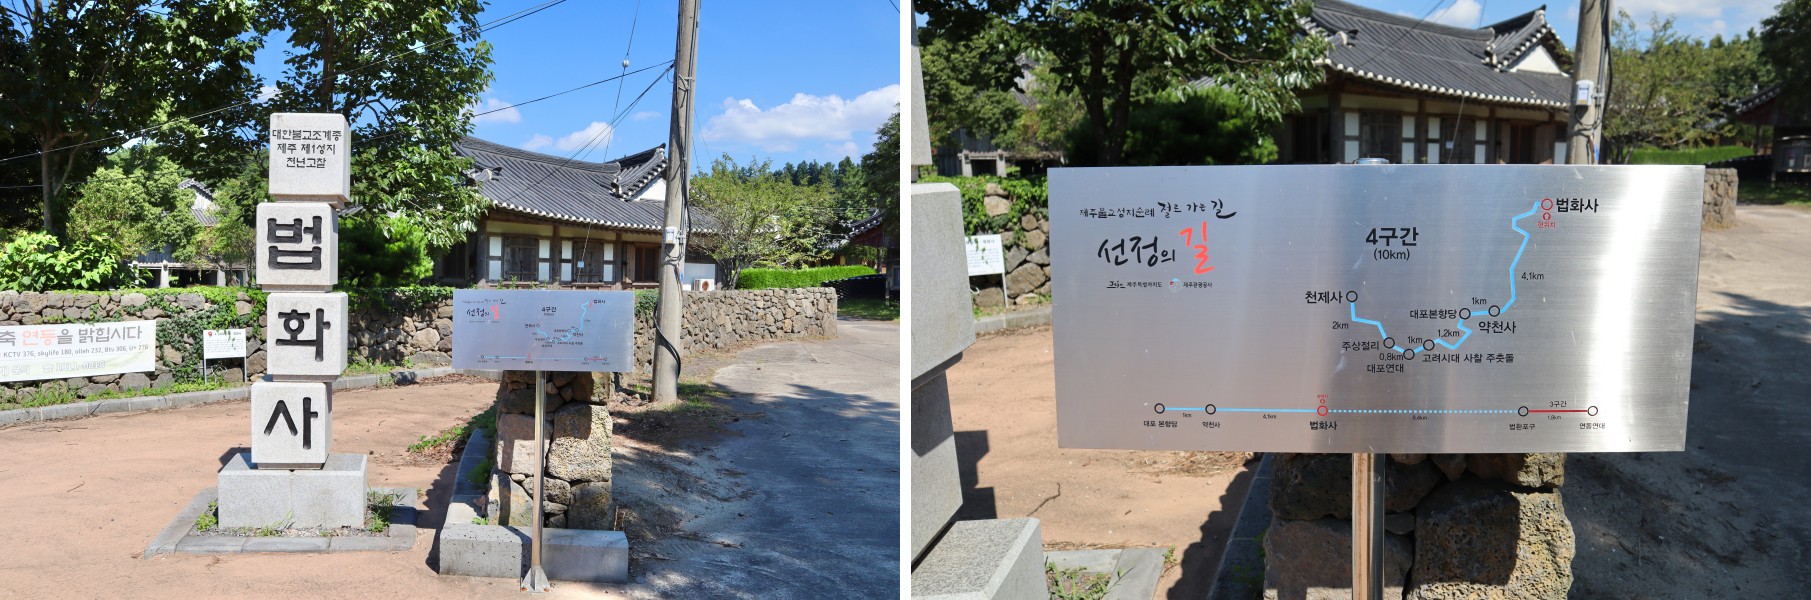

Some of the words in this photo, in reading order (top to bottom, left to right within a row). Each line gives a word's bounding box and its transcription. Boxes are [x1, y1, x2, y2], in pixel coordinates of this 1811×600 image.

[272, 128, 342, 142] 대한불교조계종
[277, 143, 297, 154] 제주
[301, 143, 336, 154] 제1성지
[286, 157, 326, 168] 천년고찰
[1079, 206, 1154, 218] 제주불교성지순례
[1186, 202, 1206, 212] 가는
[1210, 198, 1237, 219] 길
[1556, 198, 1598, 213] 법화사
[1365, 227, 1419, 246] 4구간
[1098, 236, 1176, 267] 선정의
[1179, 221, 1215, 274] 길
[1374, 249, 1410, 261] (10km)
[1305, 291, 1343, 304] 천제사
[1410, 309, 1457, 319] 대포본향당
[1332, 321, 1348, 329] 2km
[1479, 321, 1516, 334] 약천사
[22, 328, 73, 346] 연등을
[78, 325, 142, 343] 밝힙시다
[264, 216, 331, 450] 법화사
[1438, 329, 1460, 338] 1.2km
[1342, 341, 1379, 351] 주상절리
[38, 349, 59, 358] skylife
[1379, 353, 1404, 361] 0.8km
[1422, 354, 1460, 363] 고려시대
[1464, 354, 1482, 363] 사찰
[1486, 353, 1514, 363] 주춧돌
[1367, 364, 1404, 373] 대포연대
[1309, 421, 1337, 430] 법화사
